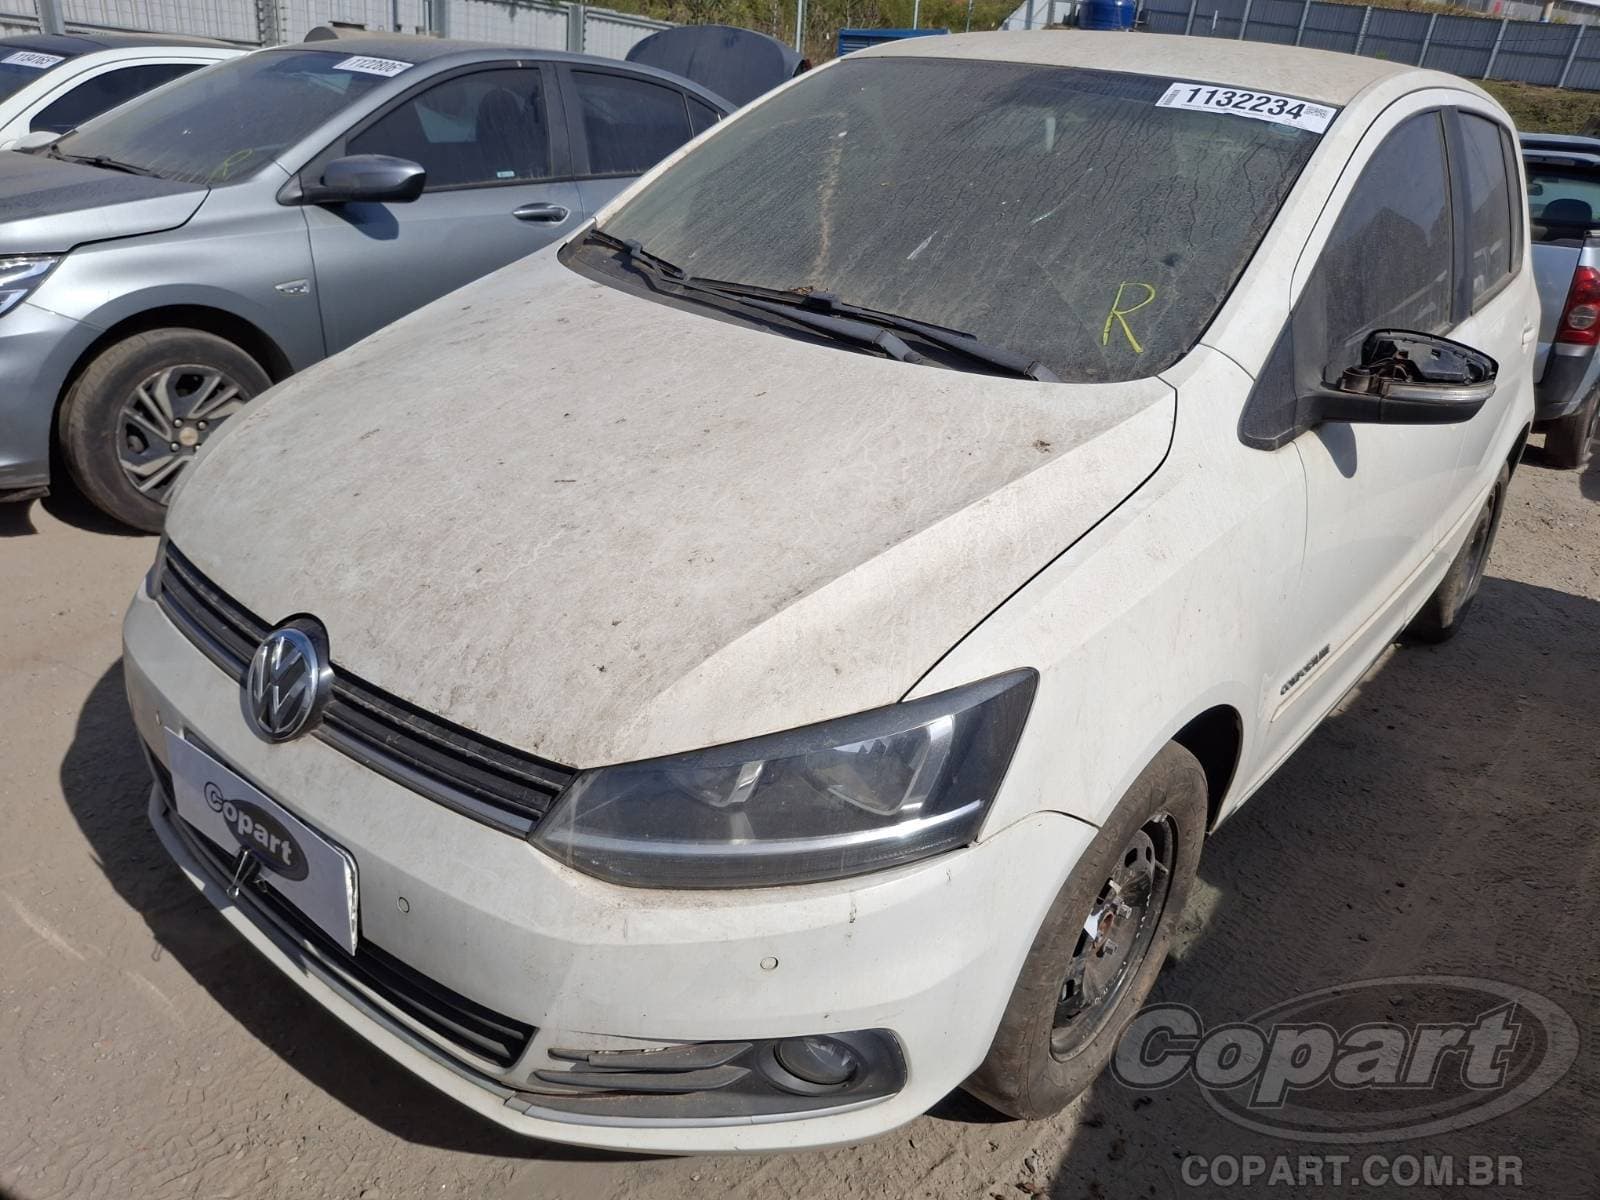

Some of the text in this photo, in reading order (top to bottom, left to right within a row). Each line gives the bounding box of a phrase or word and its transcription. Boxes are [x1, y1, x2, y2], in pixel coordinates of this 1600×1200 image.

[1186, 87, 1306, 120] 1132234
[1103, 281, 1156, 353] R
[203, 780, 295, 866] Copart
